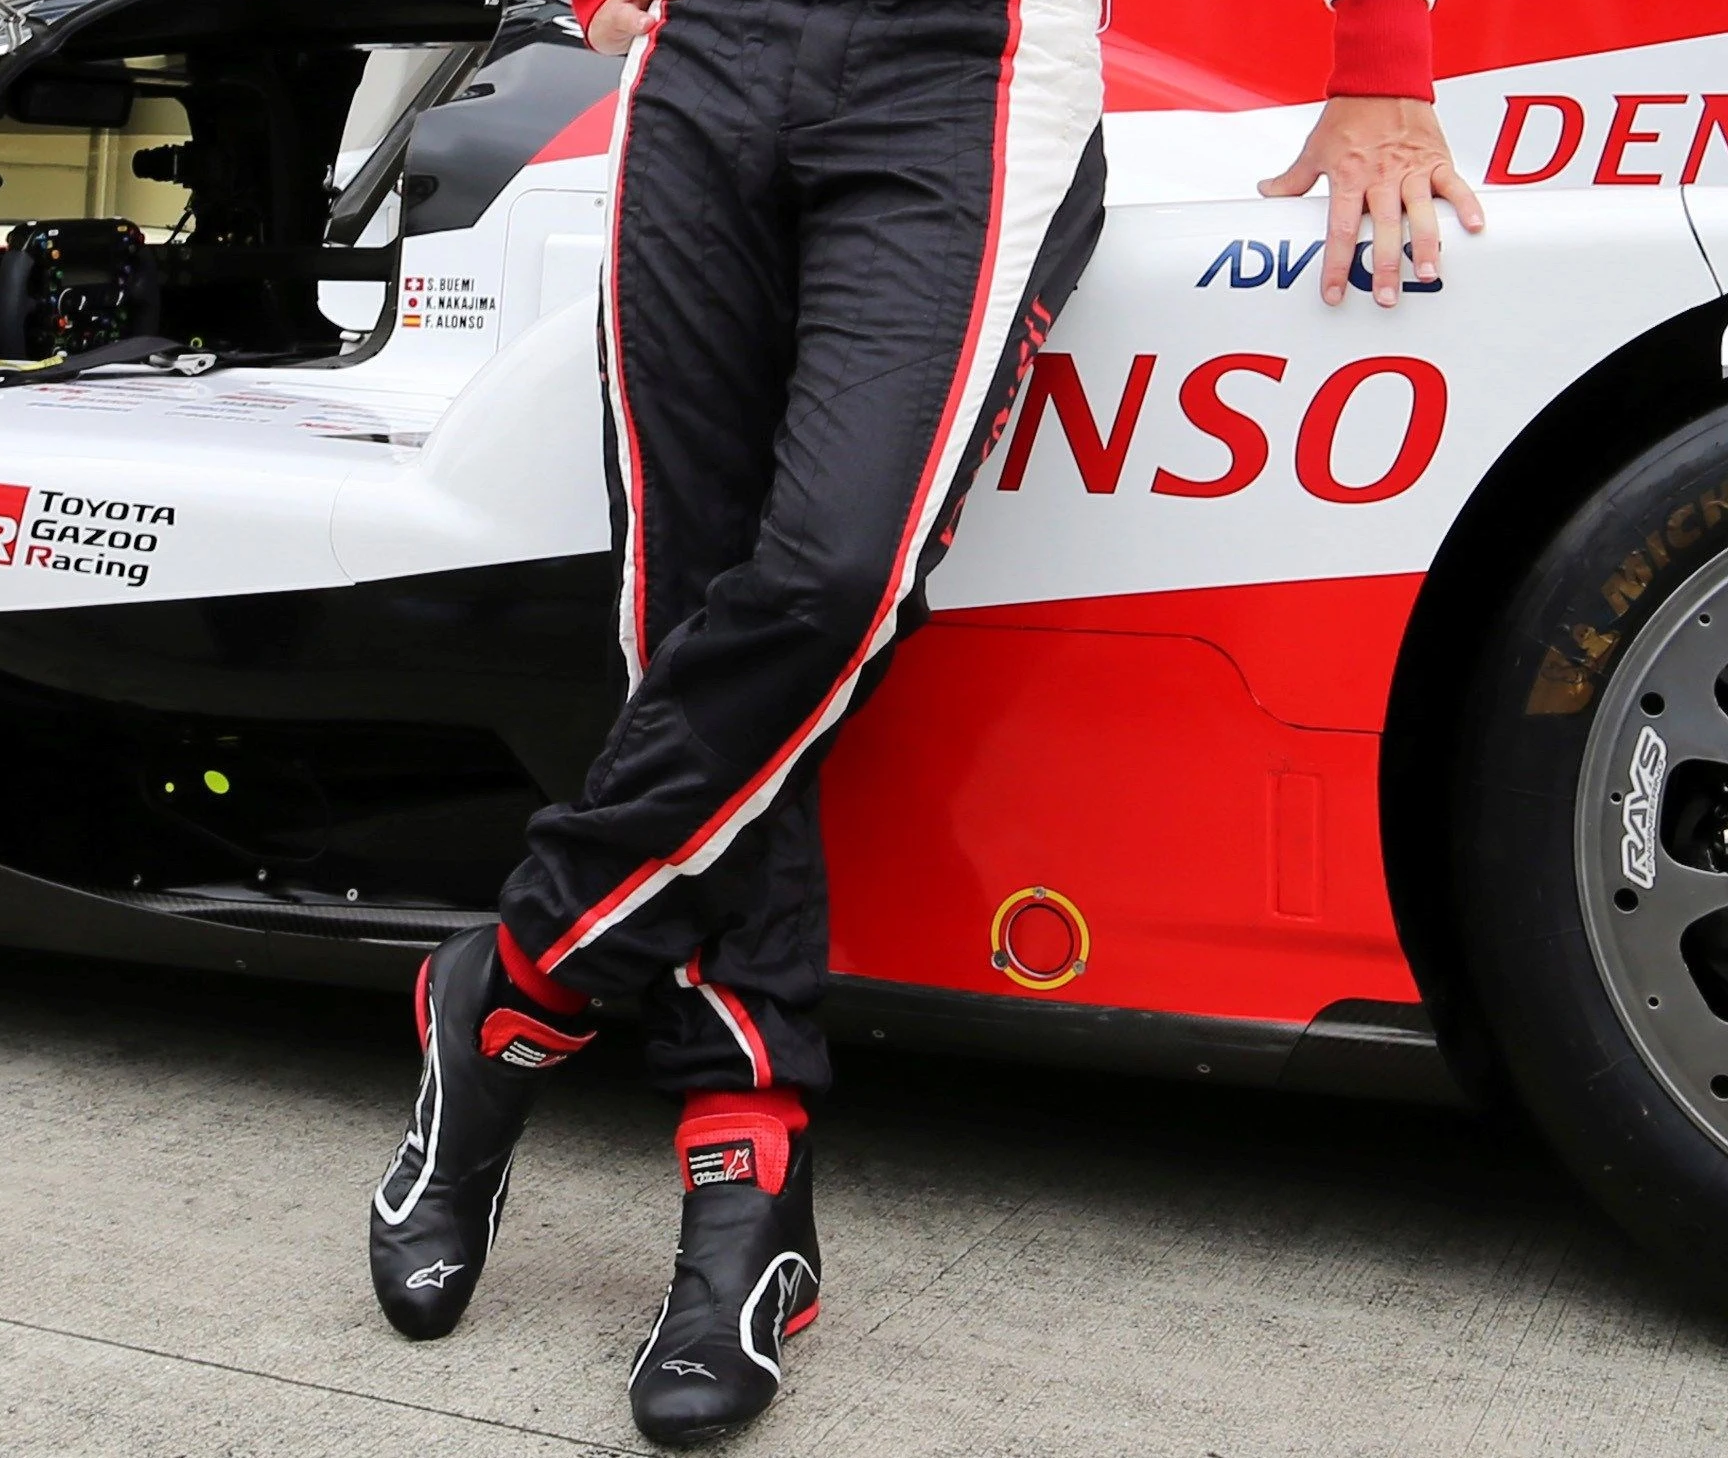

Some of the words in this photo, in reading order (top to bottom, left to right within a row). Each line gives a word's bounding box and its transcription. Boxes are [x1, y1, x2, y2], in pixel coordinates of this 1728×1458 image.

[996, 352, 1449, 505] NSO
[30, 518, 159, 553] GAZOO
[39, 489, 176, 526] TOYOTA
[24, 544, 150, 587] Racing
[1621, 725, 1669, 891] RAYS
[1646, 758, 1666, 875] ENGINEERING
